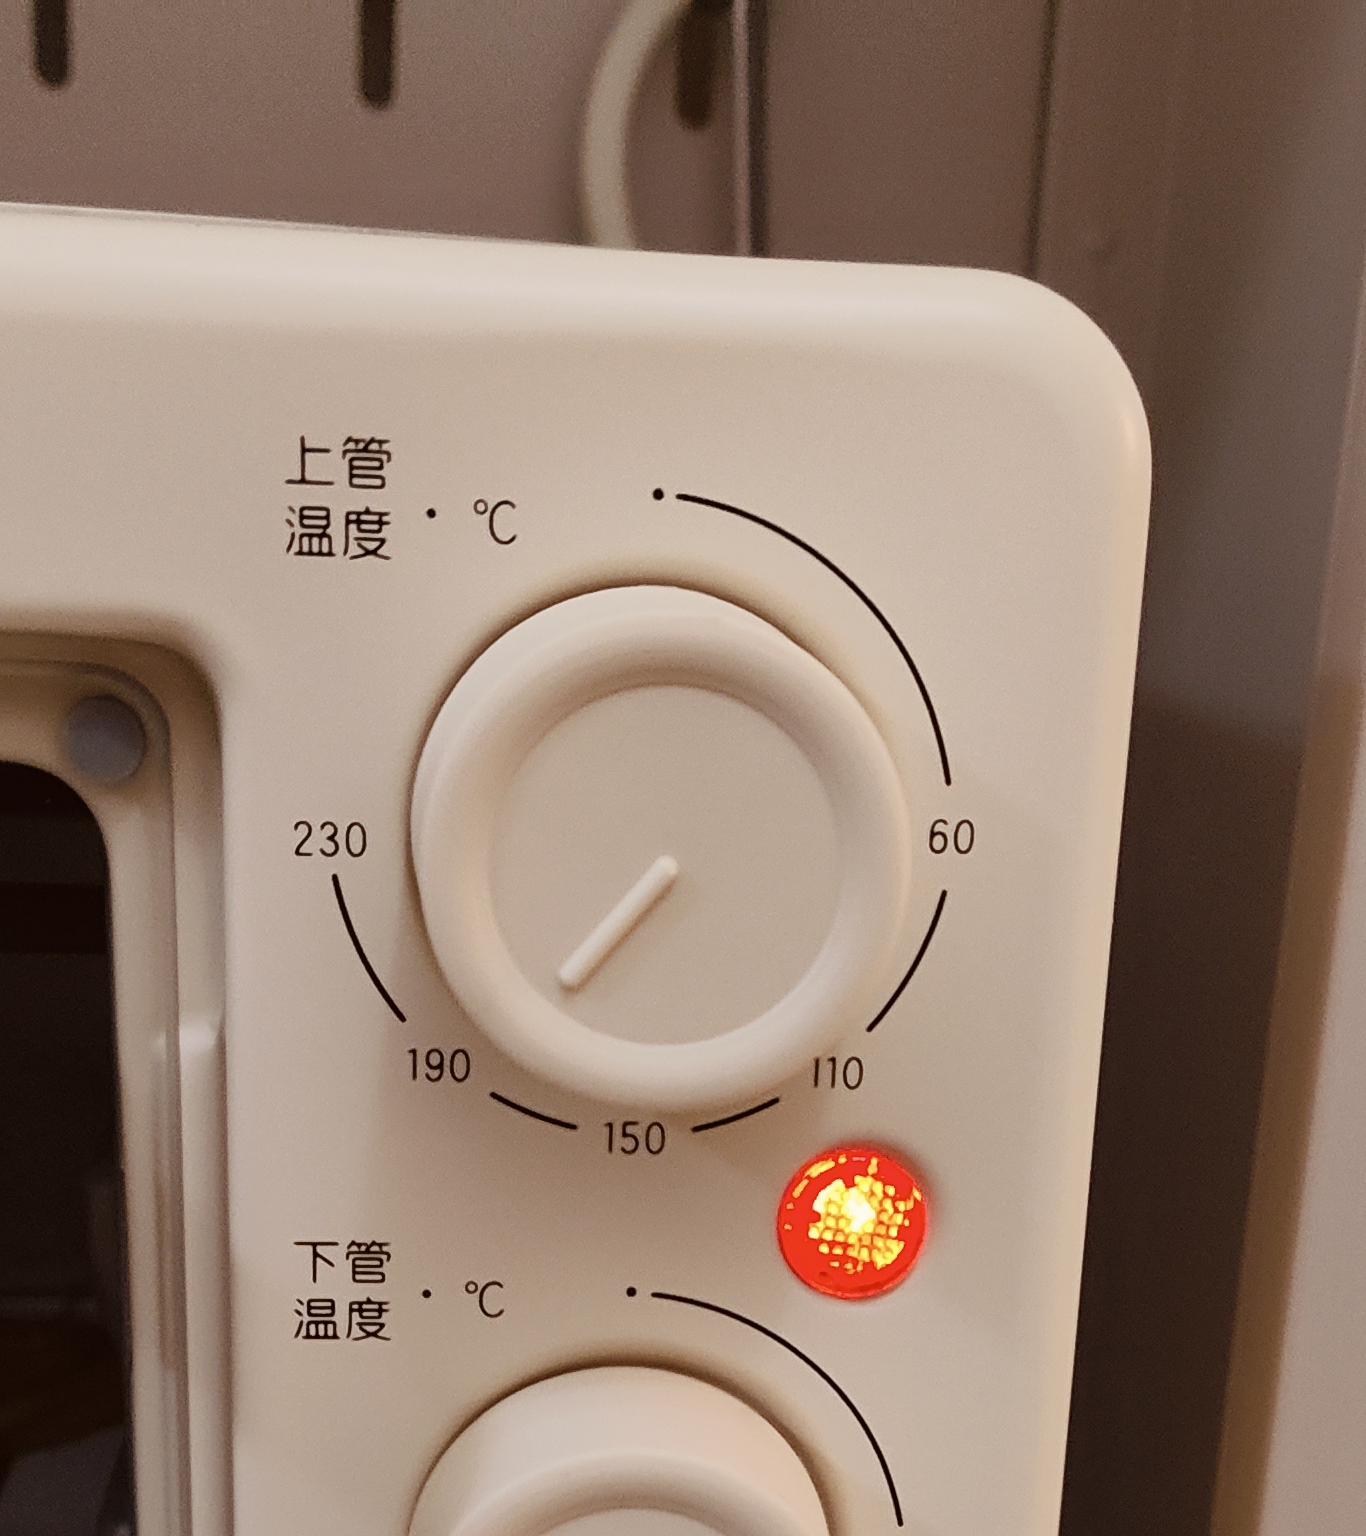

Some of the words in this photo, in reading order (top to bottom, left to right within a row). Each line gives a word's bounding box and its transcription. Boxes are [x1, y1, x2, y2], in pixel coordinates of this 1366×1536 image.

[285, 435, 392, 490] 上管
[286, 505, 391, 561] 温度
[293, 820, 368, 858] 230
[928, 818, 975, 855] 60
[408, 1047, 471, 1084] 190
[813, 1056, 864, 1091] 110
[604, 1120, 666, 1156] 150
[294, 1239, 392, 1284] 下管
[294, 1297, 390, 1341] 温度
